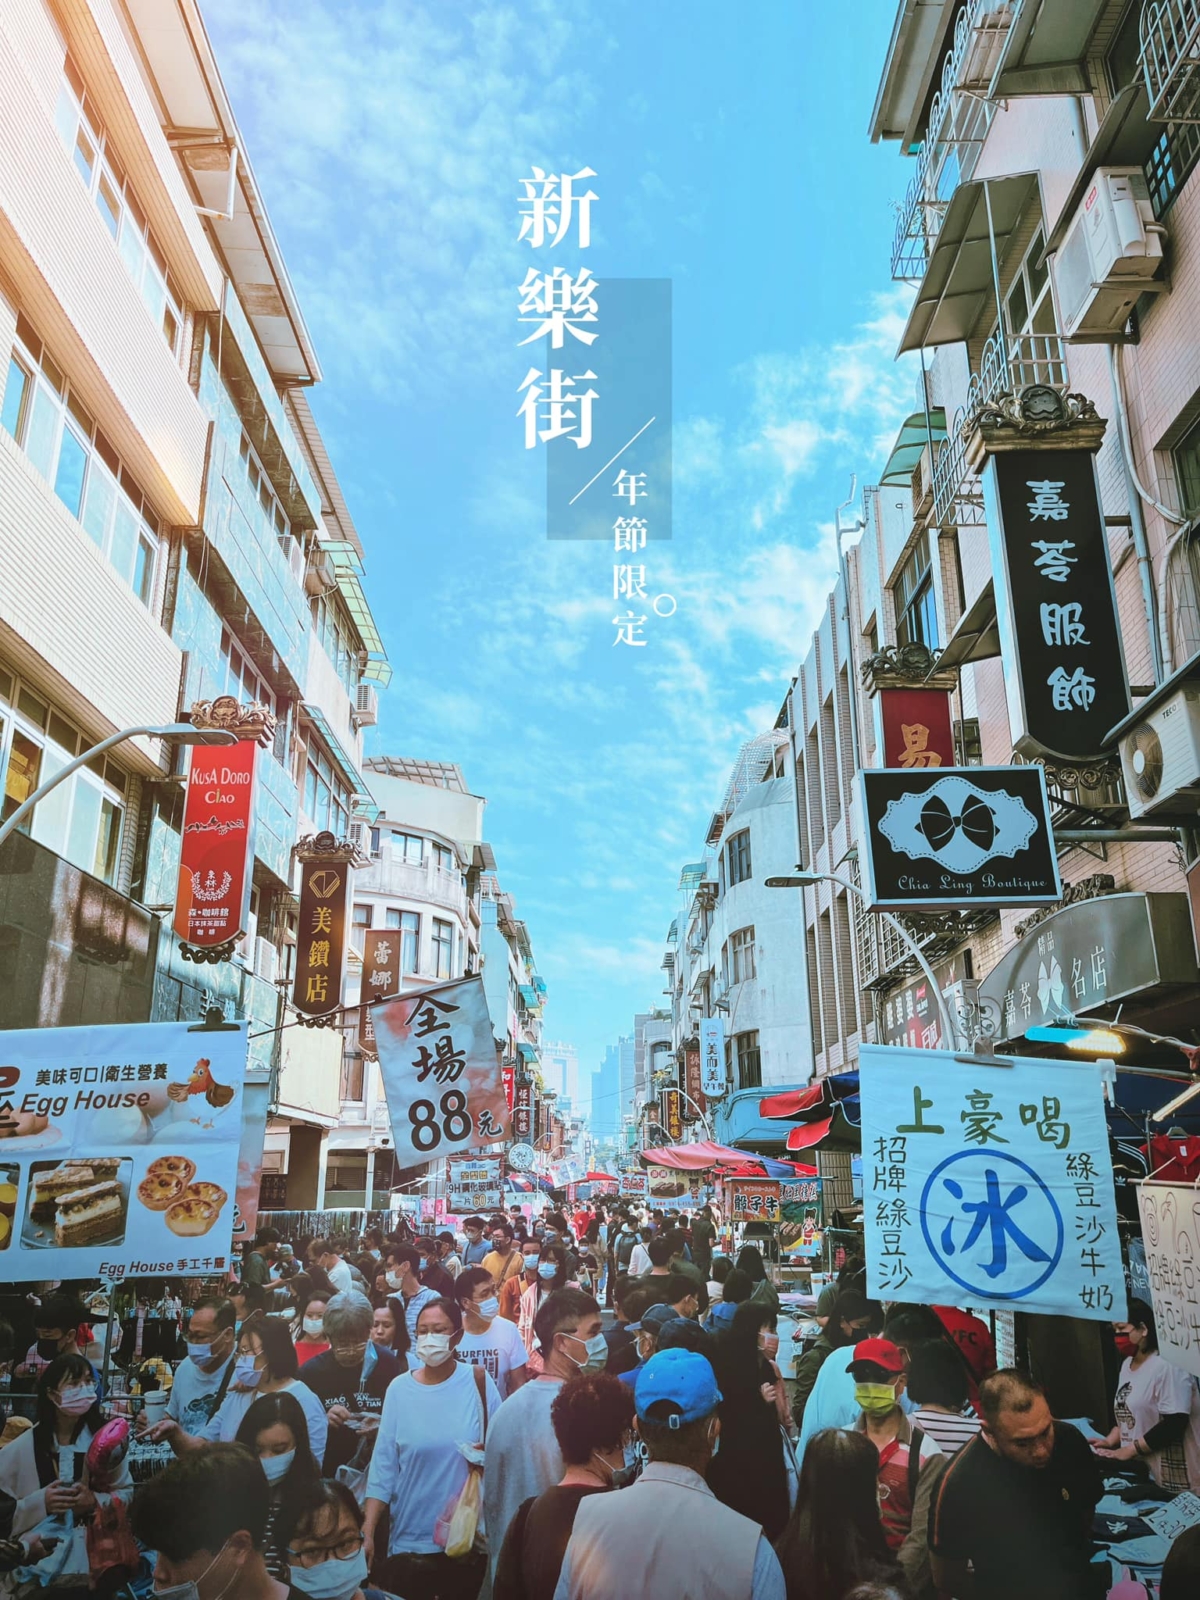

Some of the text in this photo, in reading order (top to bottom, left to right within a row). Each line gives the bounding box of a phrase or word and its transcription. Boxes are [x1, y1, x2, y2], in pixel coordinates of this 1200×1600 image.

[1026, 480, 1096, 711] 嘉苓服飾
[1162, 703, 1177, 719] TECO
[898, 873, 1047, 894] Chia Ling Boutique
[306, 906, 332, 1003] 美鑽店
[1071, 946, 1106, 998] 名店
[706, 1043, 719, 1081] 美而美
[20, 1090, 151, 1117] Egg House
[896, 1085, 1070, 1149] 上豪喝
[873, 1136, 913, 1291] 招牌綠豆沙
[941, 1169, 1051, 1278] 冰
[1066, 1153, 1113, 1311] 綠豆沙牛奶
[99, 1262, 125, 1276] Egg
[129, 1260, 174, 1273] House
